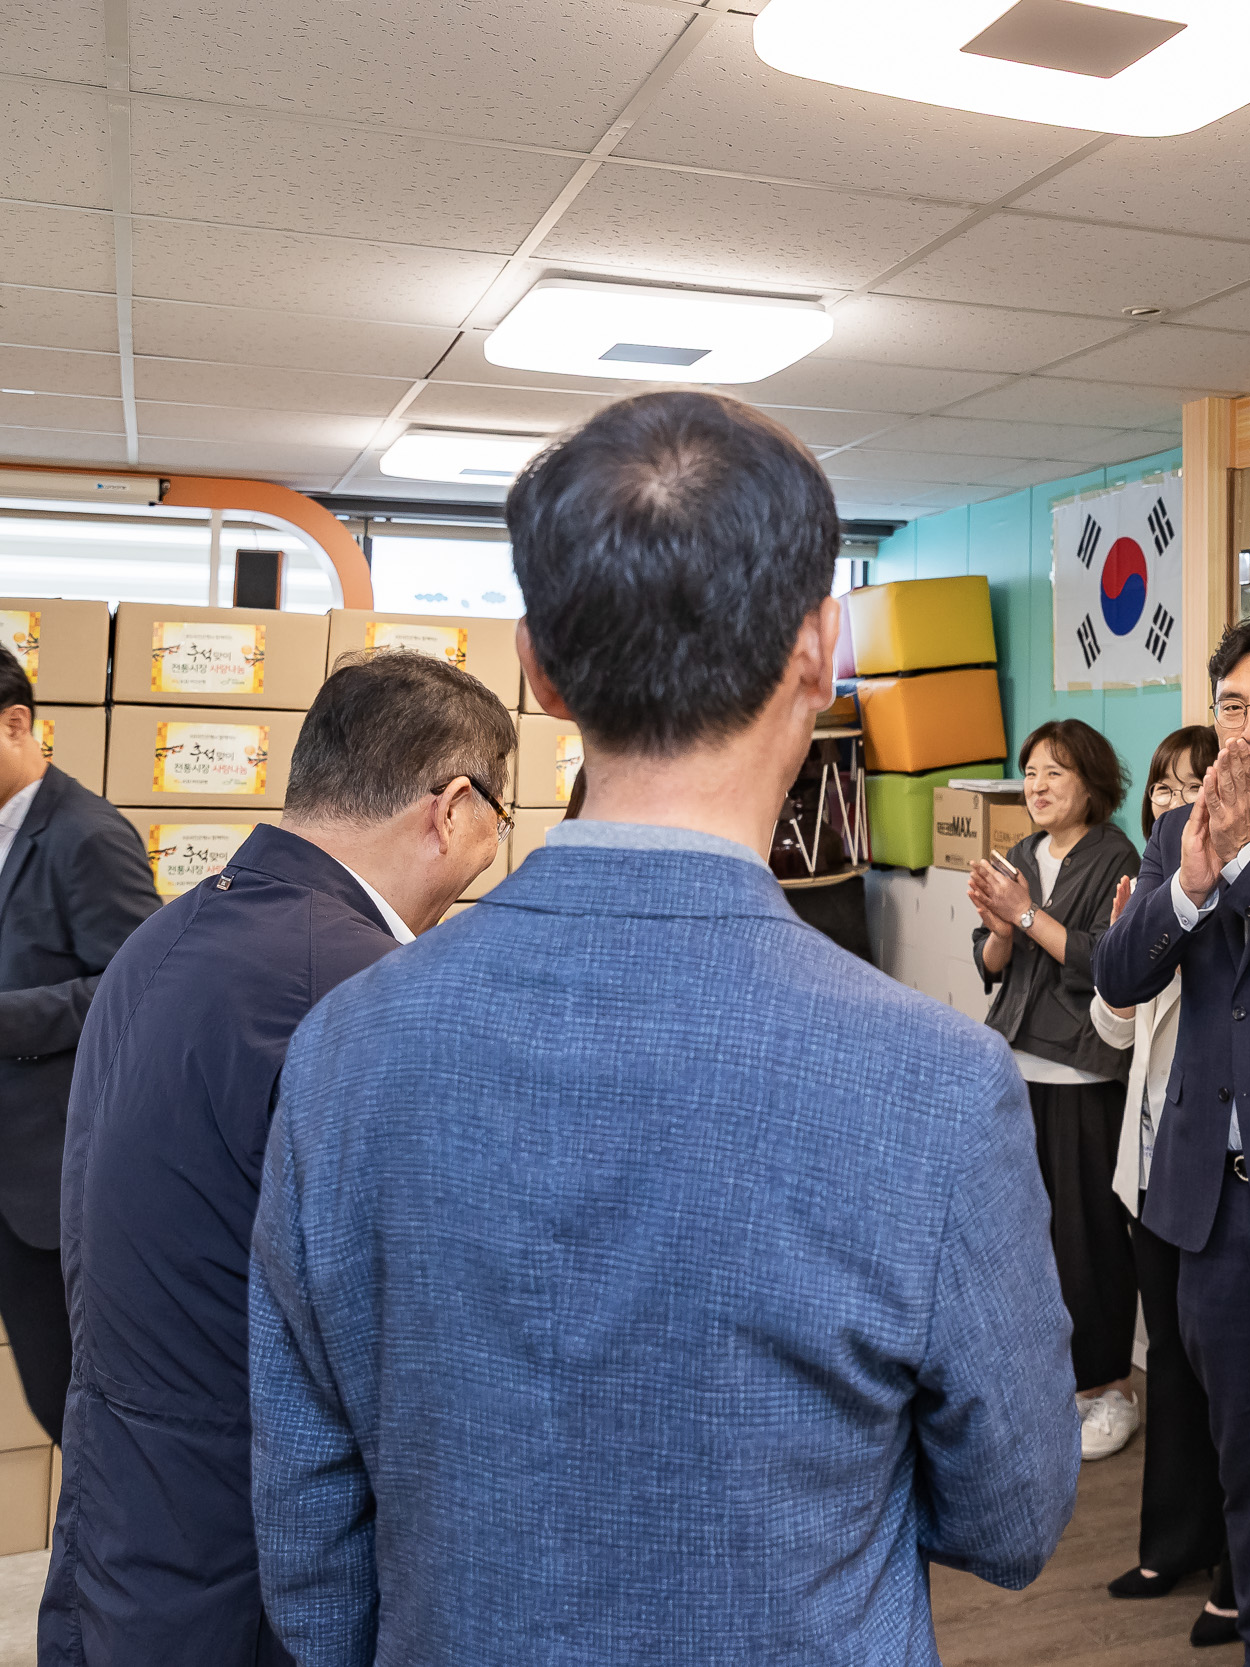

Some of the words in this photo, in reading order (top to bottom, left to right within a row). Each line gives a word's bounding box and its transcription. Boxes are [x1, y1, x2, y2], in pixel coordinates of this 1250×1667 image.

[171, 663, 207, 674] 전통시장
[210, 664, 245, 674] 사랑나눔
[174, 763, 210, 774] 전통시장
[212, 764, 247, 775] 사랑나눔
[952, 816, 972, 834] MAX
[167, 865, 203, 876] 전통시장
